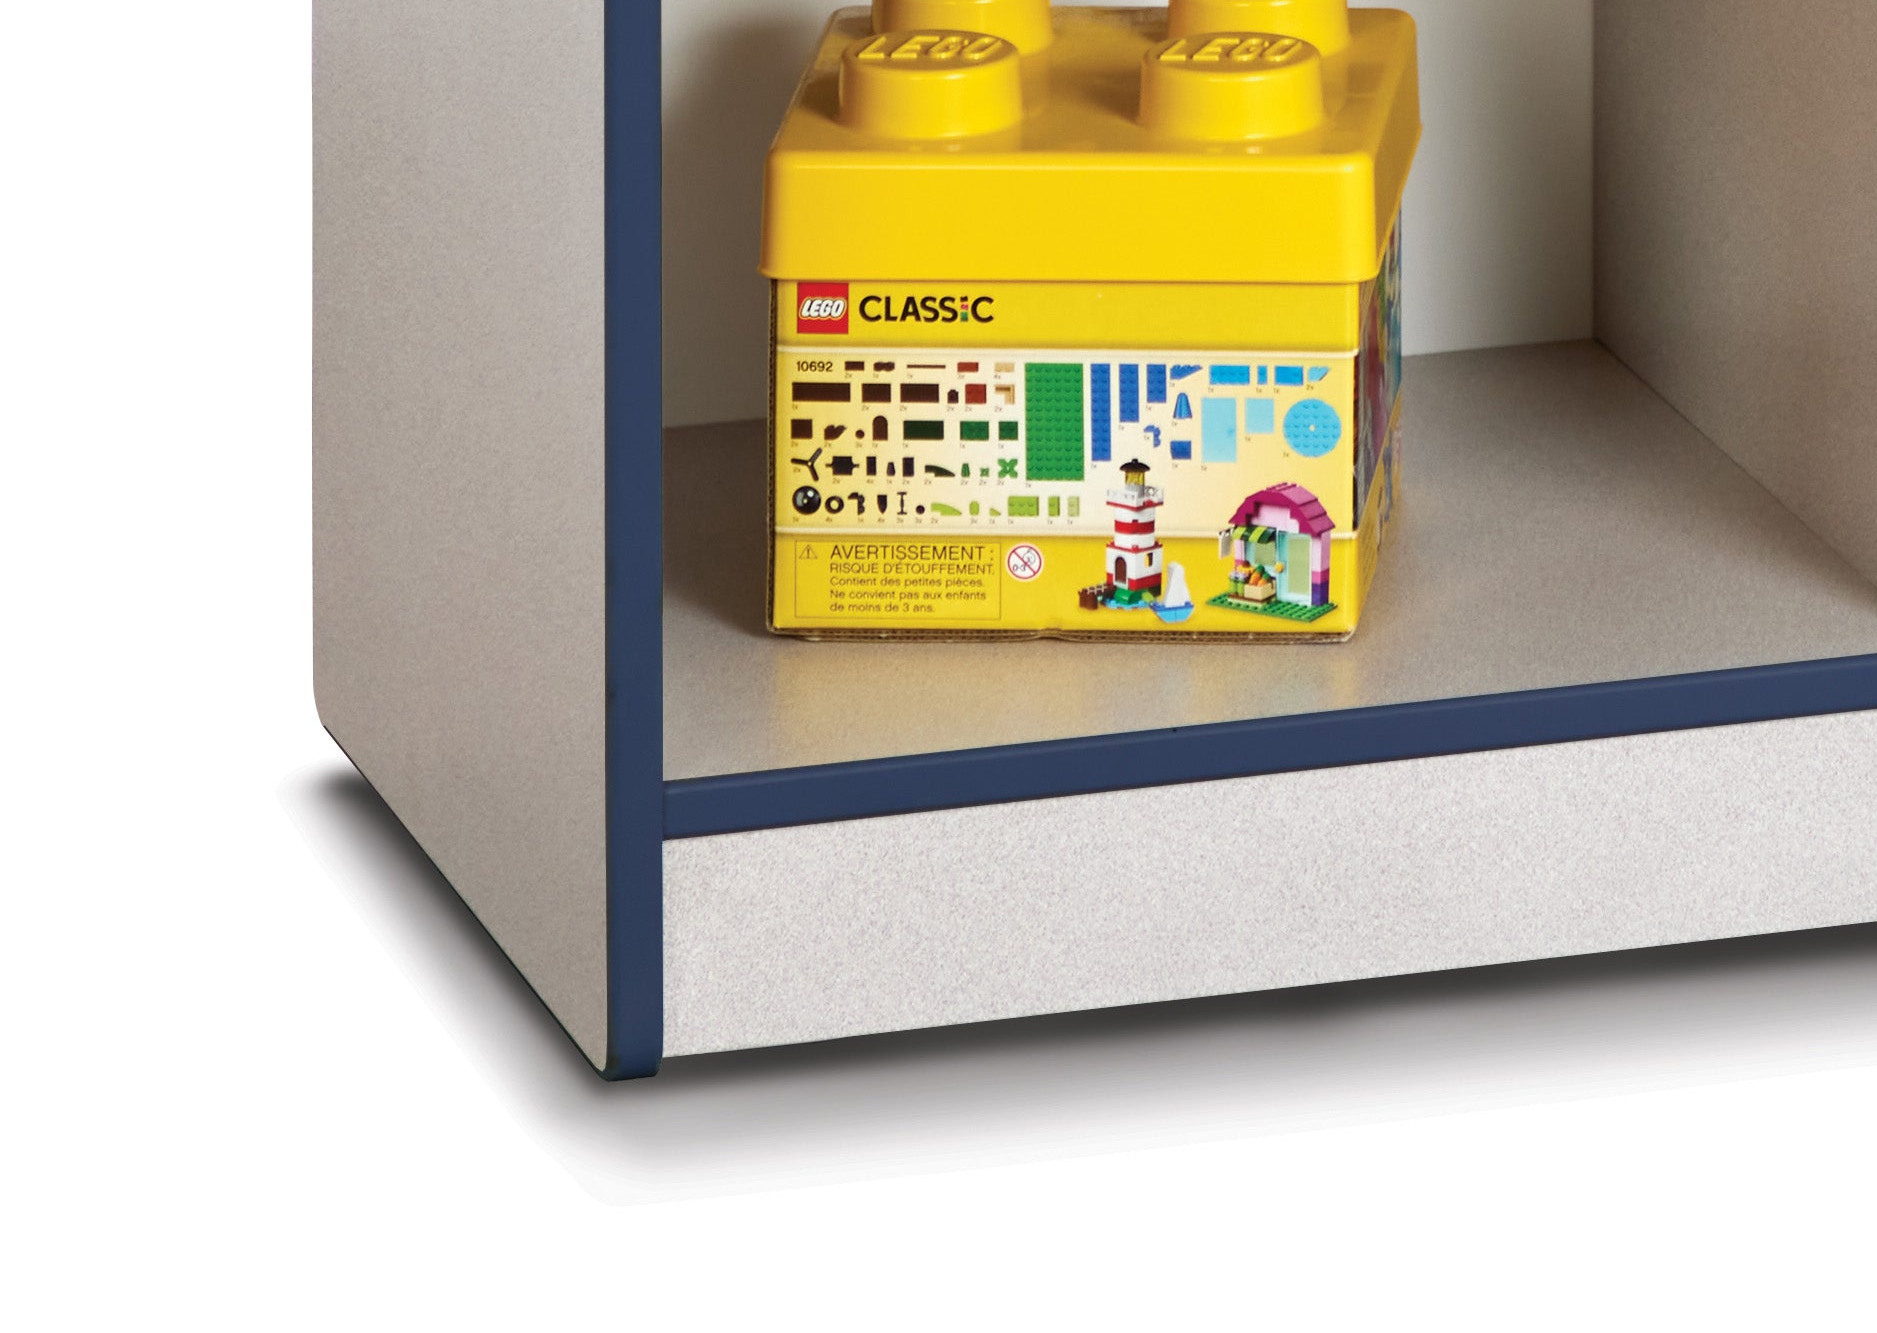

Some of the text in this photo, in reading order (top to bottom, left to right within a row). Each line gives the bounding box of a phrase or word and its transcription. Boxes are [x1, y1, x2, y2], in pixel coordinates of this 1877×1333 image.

[857, 35, 1002, 60] LEGO
[1158, 37, 1300, 62] LEGO
[799, 296, 847, 320] LEGO
[796, 360, 833, 374] 10692
[830, 544, 986, 561] AVERTISSEMENT
[830, 563, 879, 575] RISQUE
[829, 576, 877, 588] Contient
[880, 576, 901, 588] des
[904, 576, 943, 589] petites
[830, 589, 987, 602] Ne convient pas aux enfants
[829, 602, 936, 614] de moins de 3 ans.
